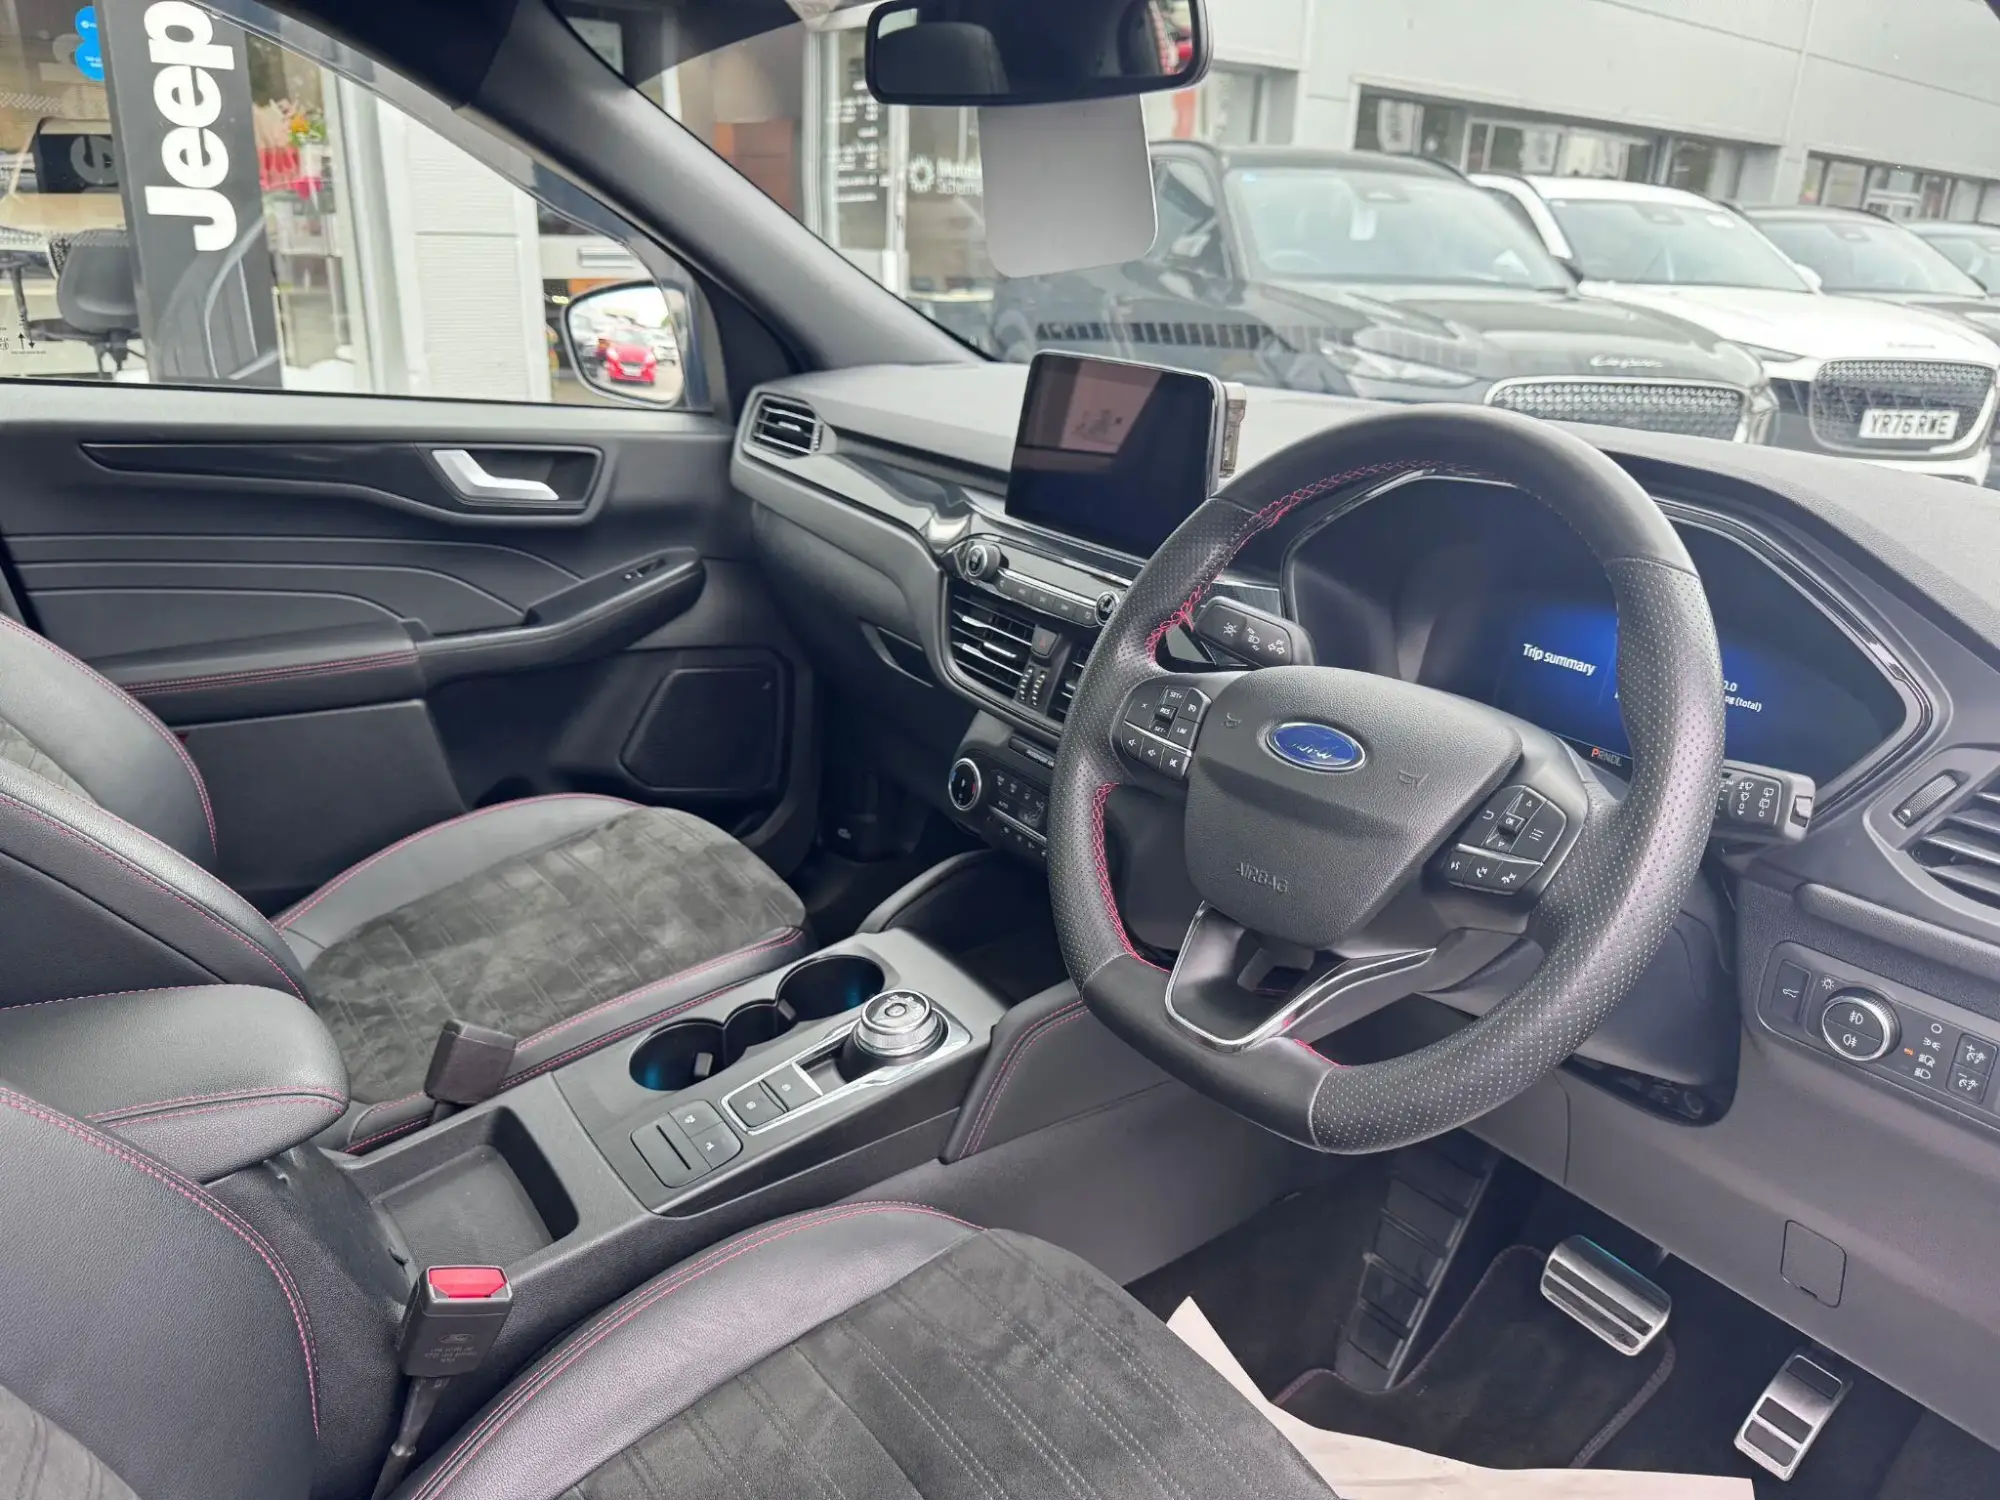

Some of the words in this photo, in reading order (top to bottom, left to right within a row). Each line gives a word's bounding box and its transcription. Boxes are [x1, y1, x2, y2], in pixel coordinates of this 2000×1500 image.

[144, 1, 238, 251] Jeep
[1523, 643, 1544, 661] Trip
[1543, 652, 1596, 676] summary
[1159, 707, 1170, 715] RES
[1735, 697, 1762, 712] (total)
